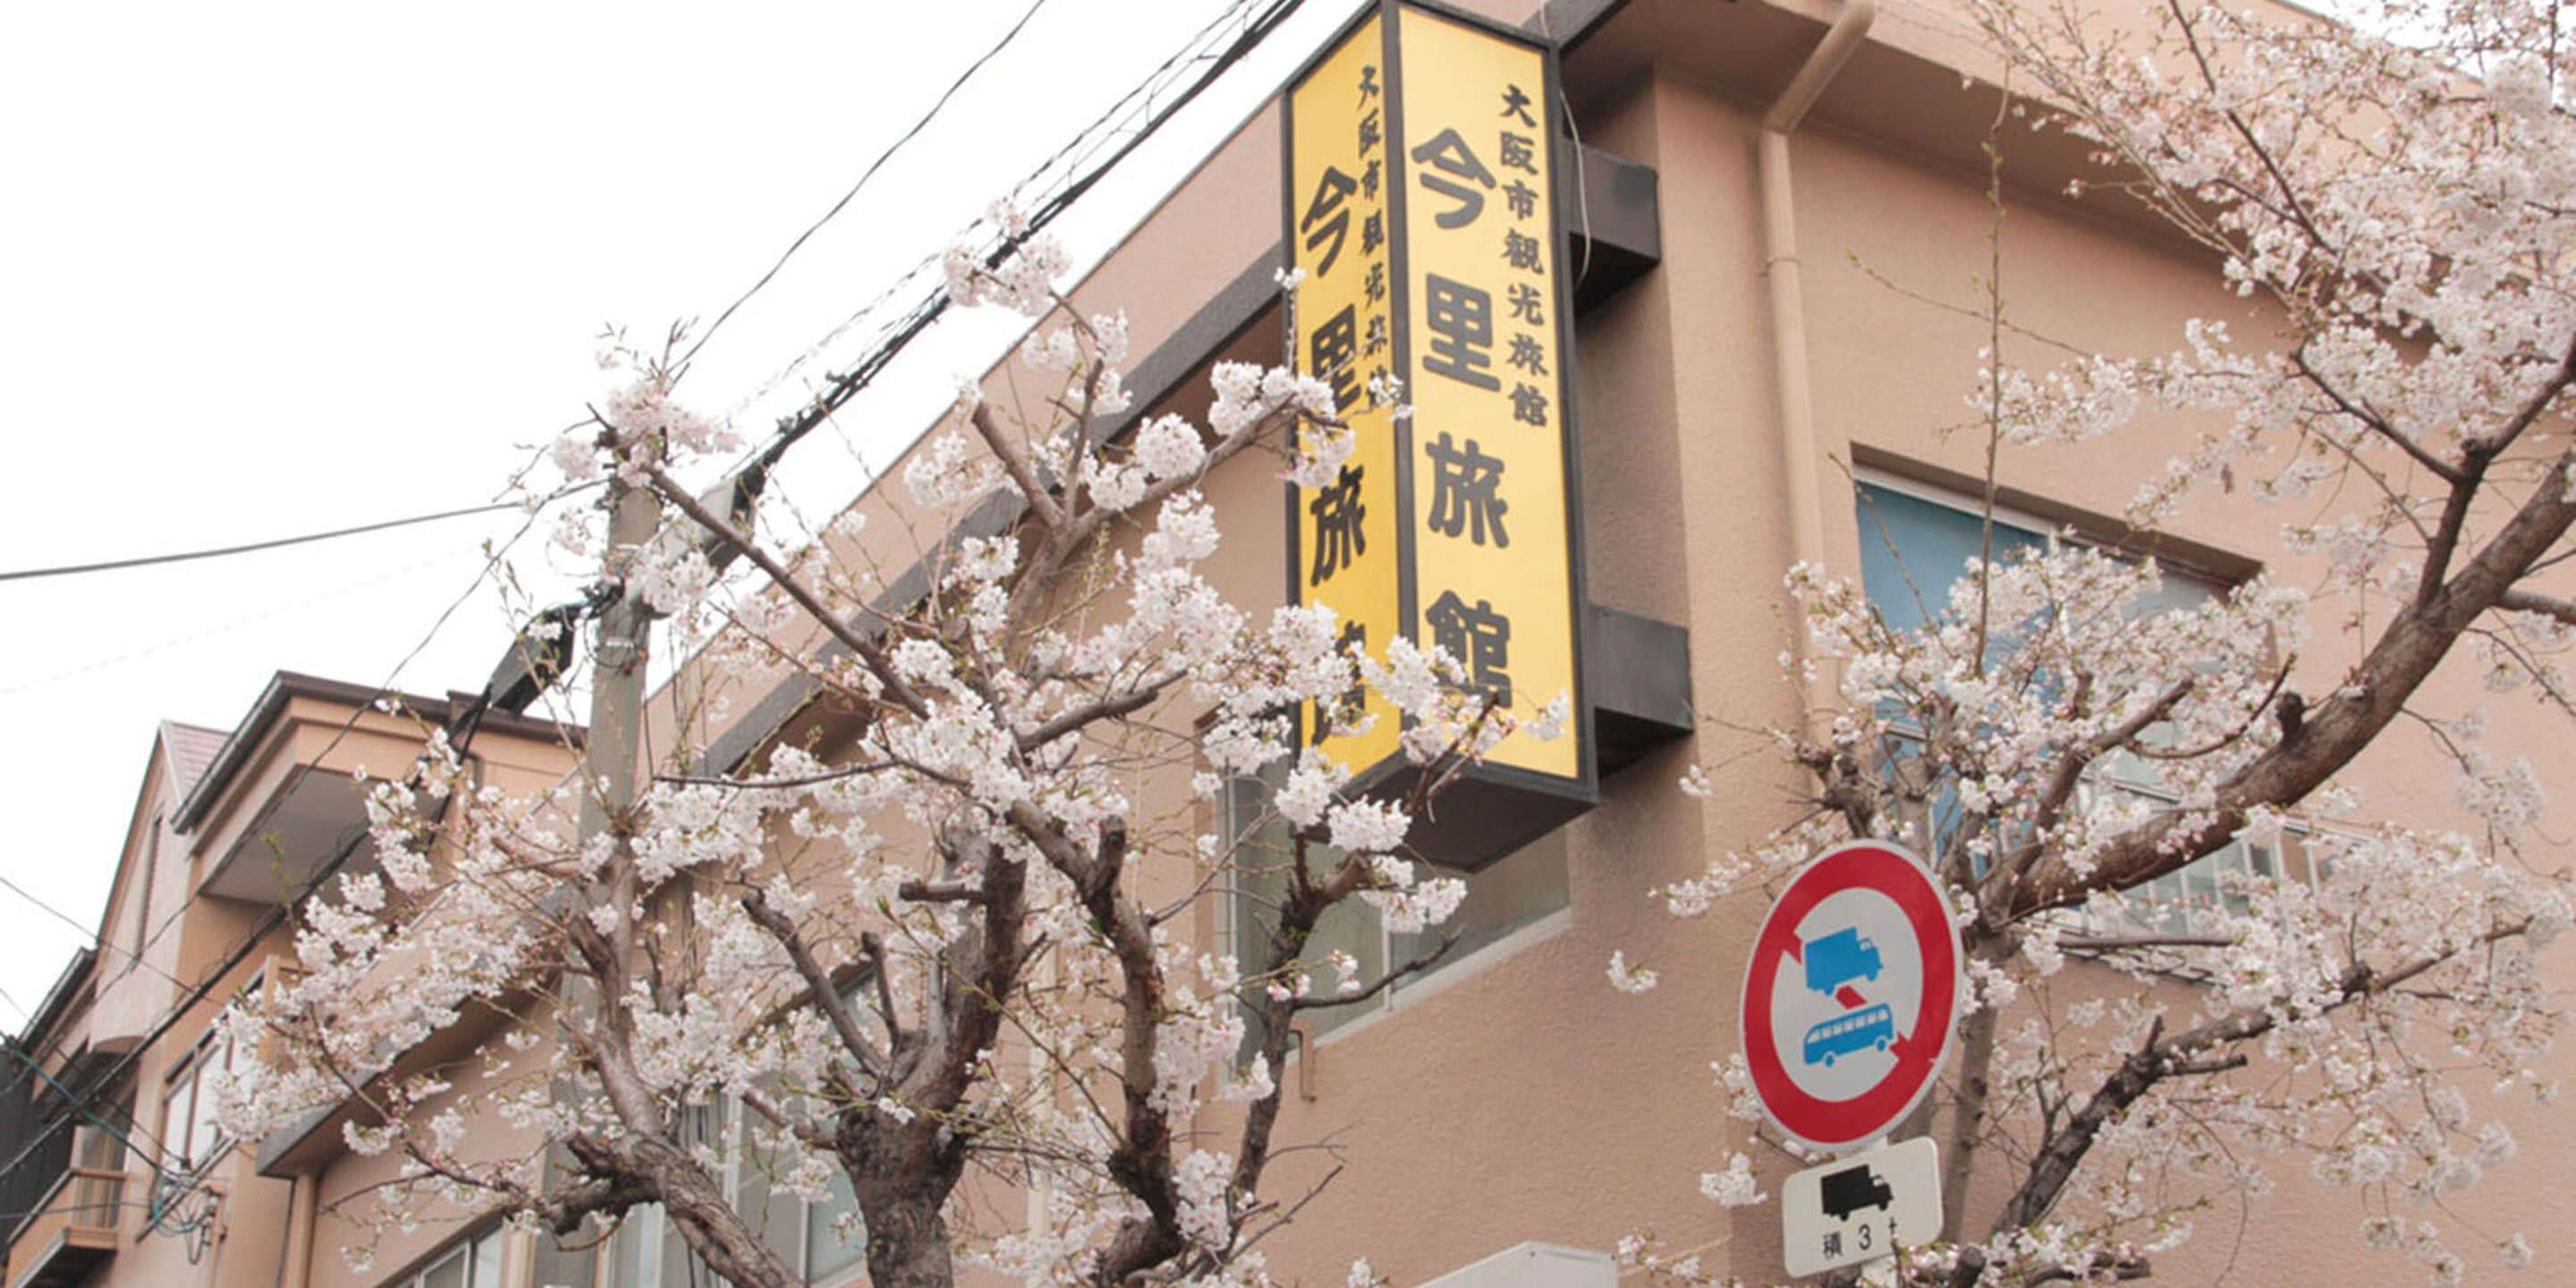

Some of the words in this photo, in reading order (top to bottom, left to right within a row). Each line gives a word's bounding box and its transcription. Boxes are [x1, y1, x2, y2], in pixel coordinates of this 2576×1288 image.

[1411, 127, 1512, 708] 今里旅館
[1499, 83, 1549, 428] 大阪市観光旅館
